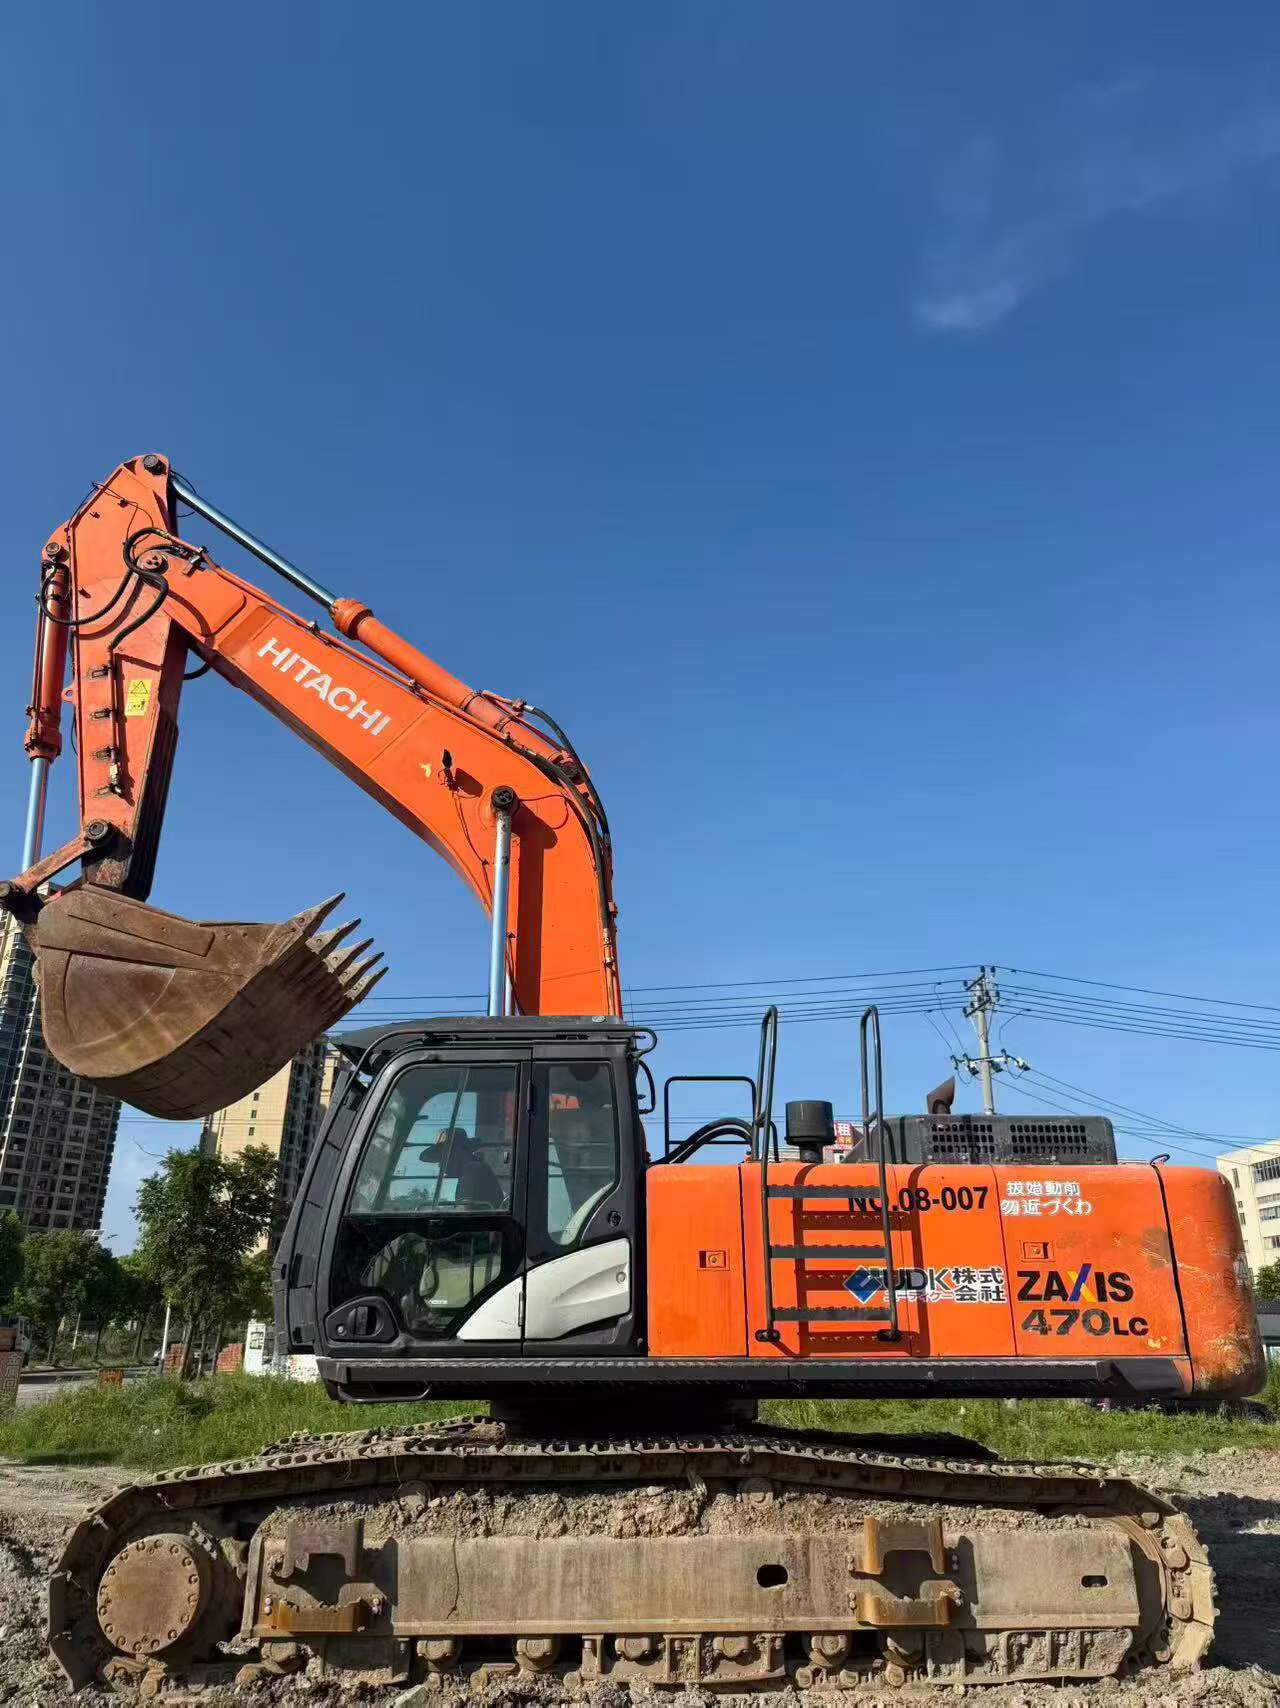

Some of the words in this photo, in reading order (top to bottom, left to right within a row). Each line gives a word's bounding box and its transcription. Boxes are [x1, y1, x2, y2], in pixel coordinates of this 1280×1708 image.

[257, 637, 391, 736] HITACHI
[952, 1267, 1004, 1284] 株式
[1017, 1263, 1134, 1302] ZAXIS
[954, 1284, 1006, 1301] 会社
